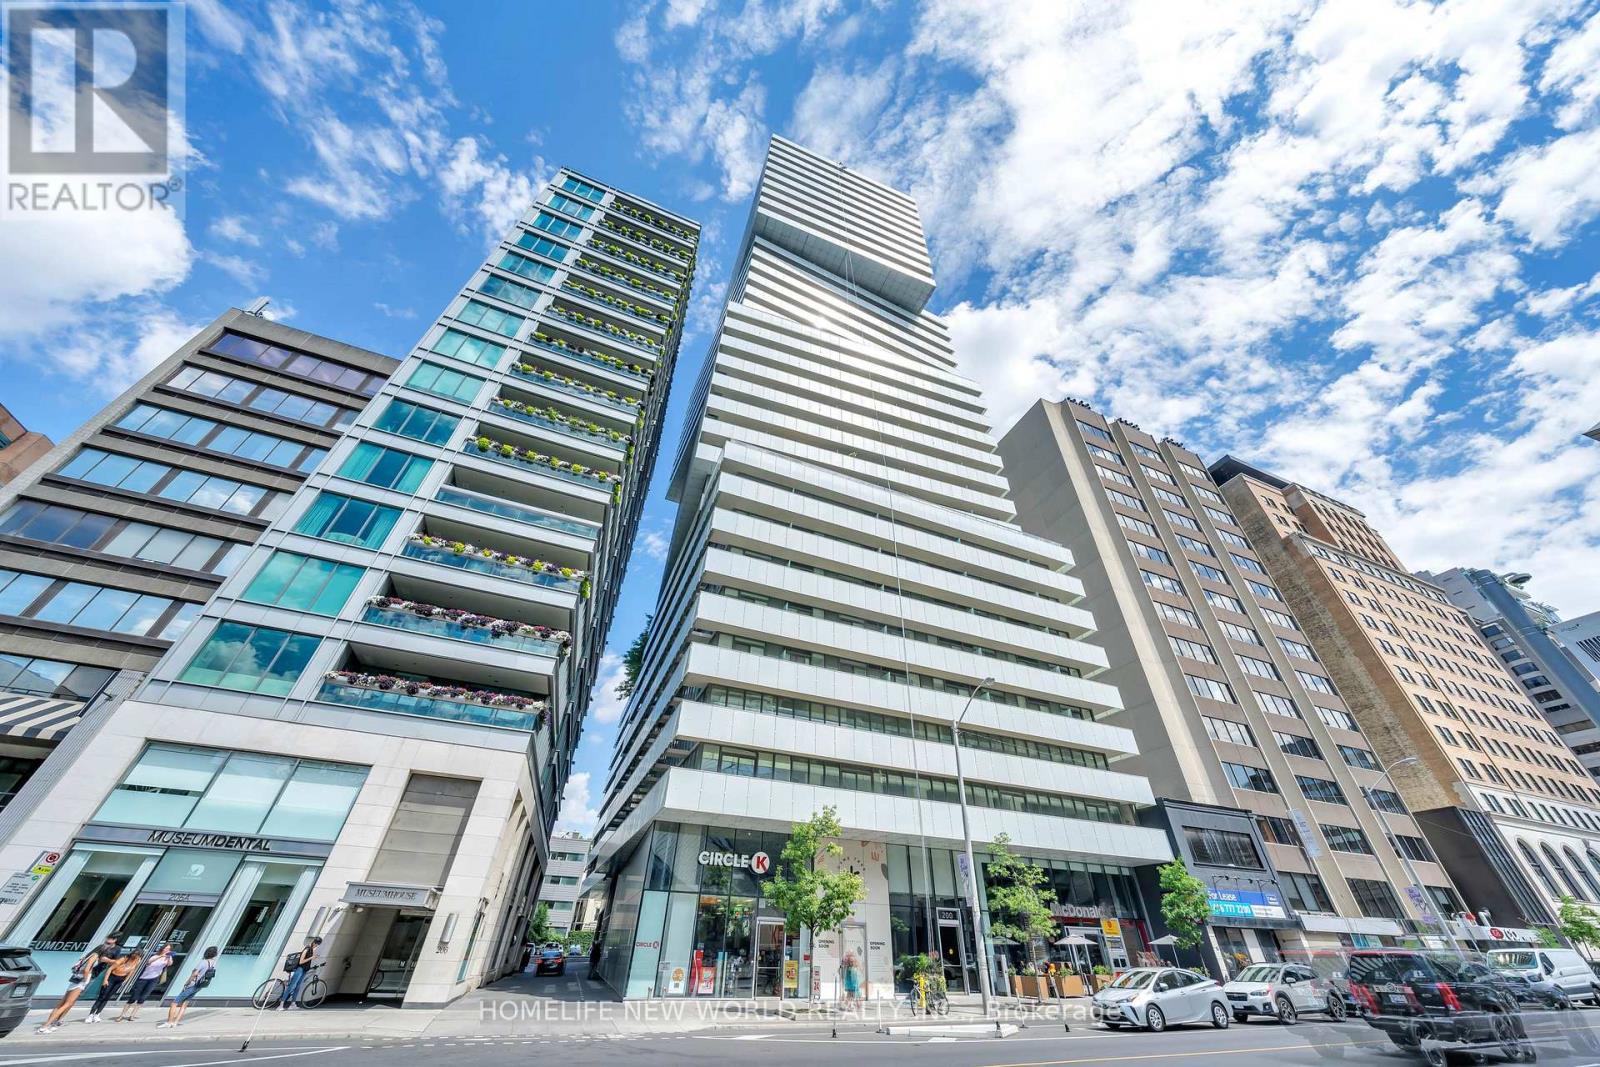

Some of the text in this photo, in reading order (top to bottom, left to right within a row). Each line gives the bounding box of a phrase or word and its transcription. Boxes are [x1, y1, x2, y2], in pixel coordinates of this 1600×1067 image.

[147, 830, 271, 851] MUSEUMDENTAL
[698, 851, 769, 874] CIRCLE K
[1218, 890, 1238, 901] Lease
[1050, 903, 1111, 919] McDonal
